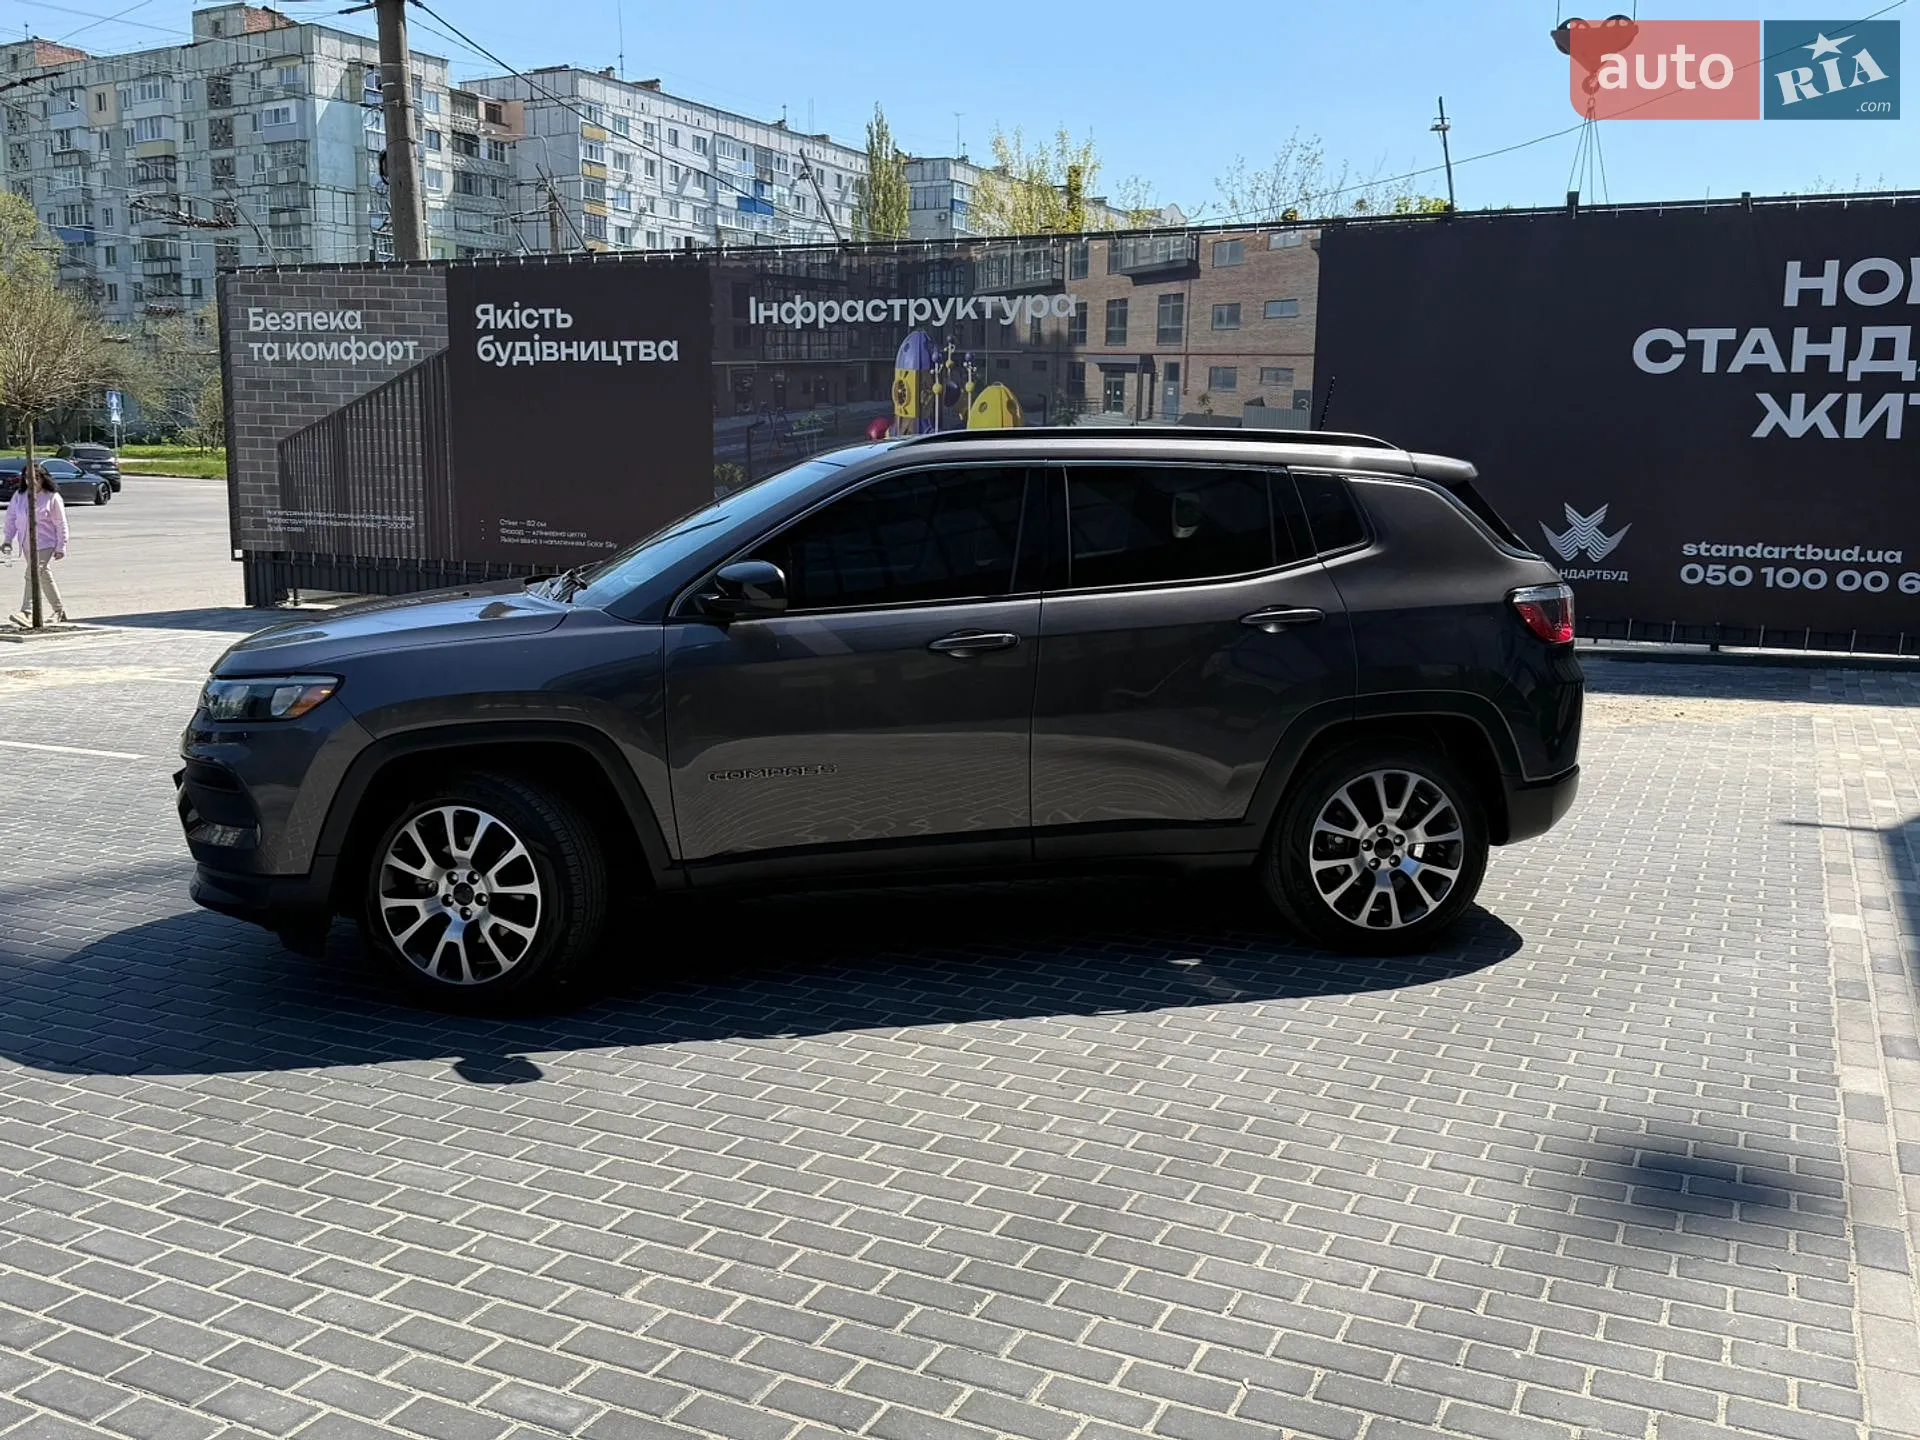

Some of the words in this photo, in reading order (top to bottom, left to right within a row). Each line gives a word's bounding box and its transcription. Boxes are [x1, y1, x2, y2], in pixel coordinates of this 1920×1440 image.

[247, 306, 363, 332] Безпека
[475, 301, 574, 330] Якість
[748, 292, 1077, 329] Інфраструктура
[248, 342, 280, 362] та
[286, 335, 419, 366] комфорт
[476, 333, 680, 368] будівництва
[1632, 325, 1920, 382] СТАНД
[1681, 541, 1903, 564] standartbud.ua
[1559, 568, 1629, 583] НДАРТБУД
[1680, 563, 1754, 587] 050
[1760, 566, 1829, 590] 100
[1835, 569, 1890, 593] 00
[708, 764, 838, 782] COMPASS
